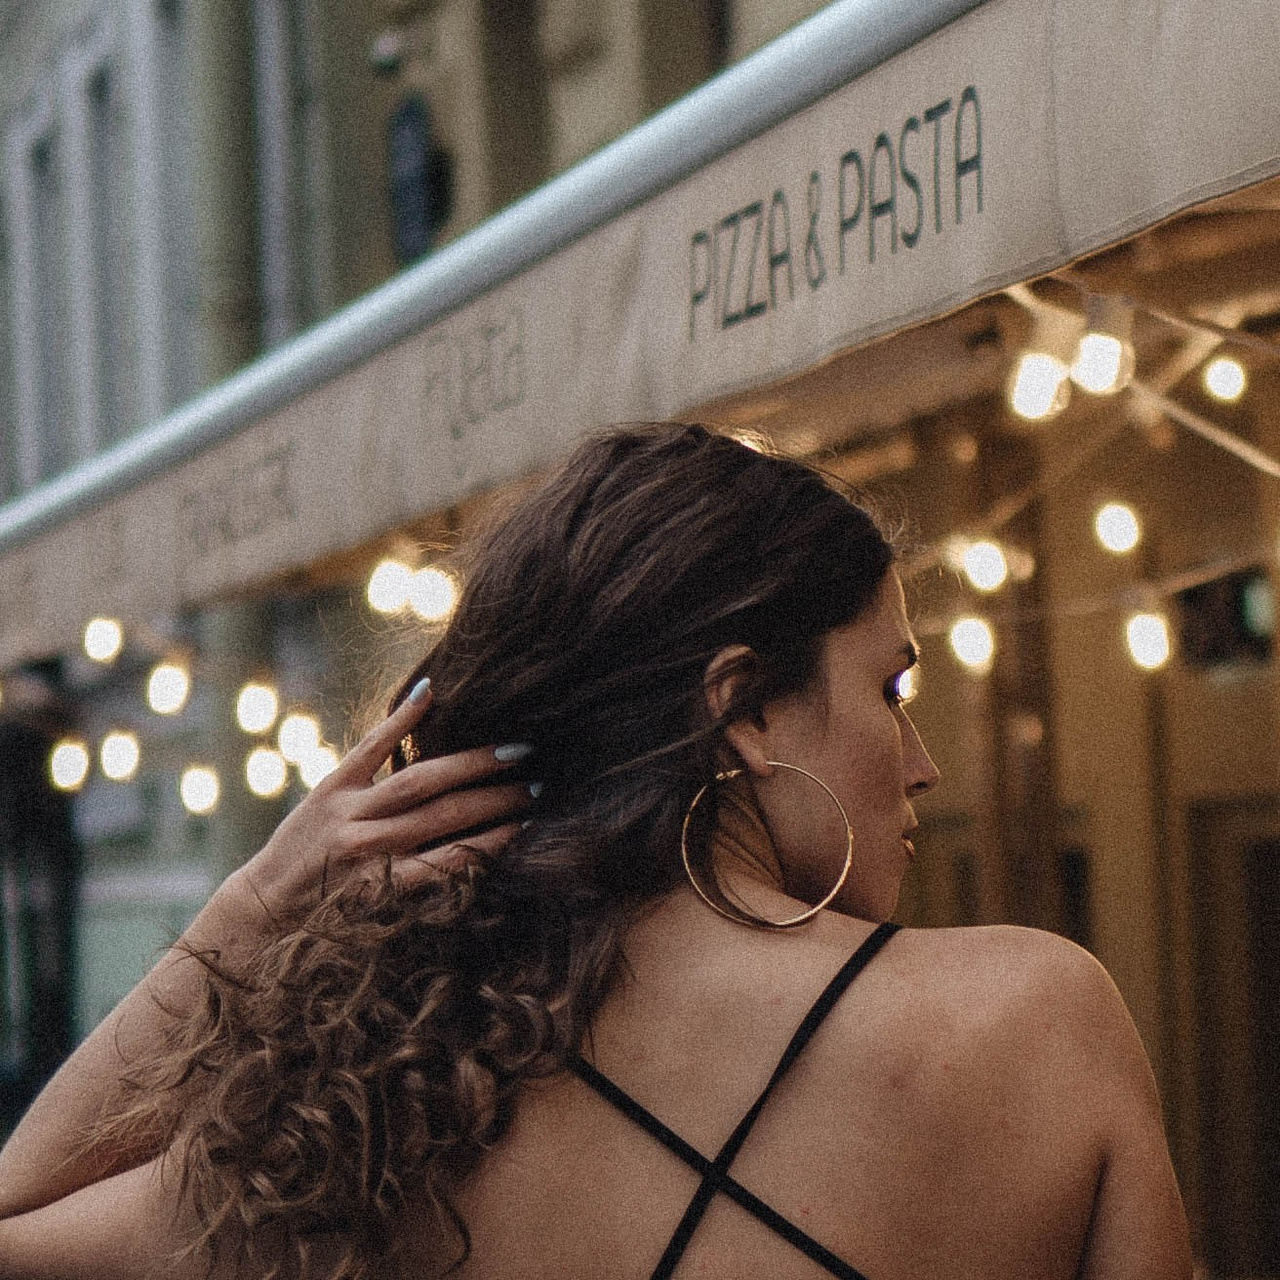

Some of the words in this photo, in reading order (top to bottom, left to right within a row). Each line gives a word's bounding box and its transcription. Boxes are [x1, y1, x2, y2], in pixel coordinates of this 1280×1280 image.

[688, 187, 795, 344] PIZZA
[804, 169, 828, 291] &
[837, 83, 985, 276] PASTA
